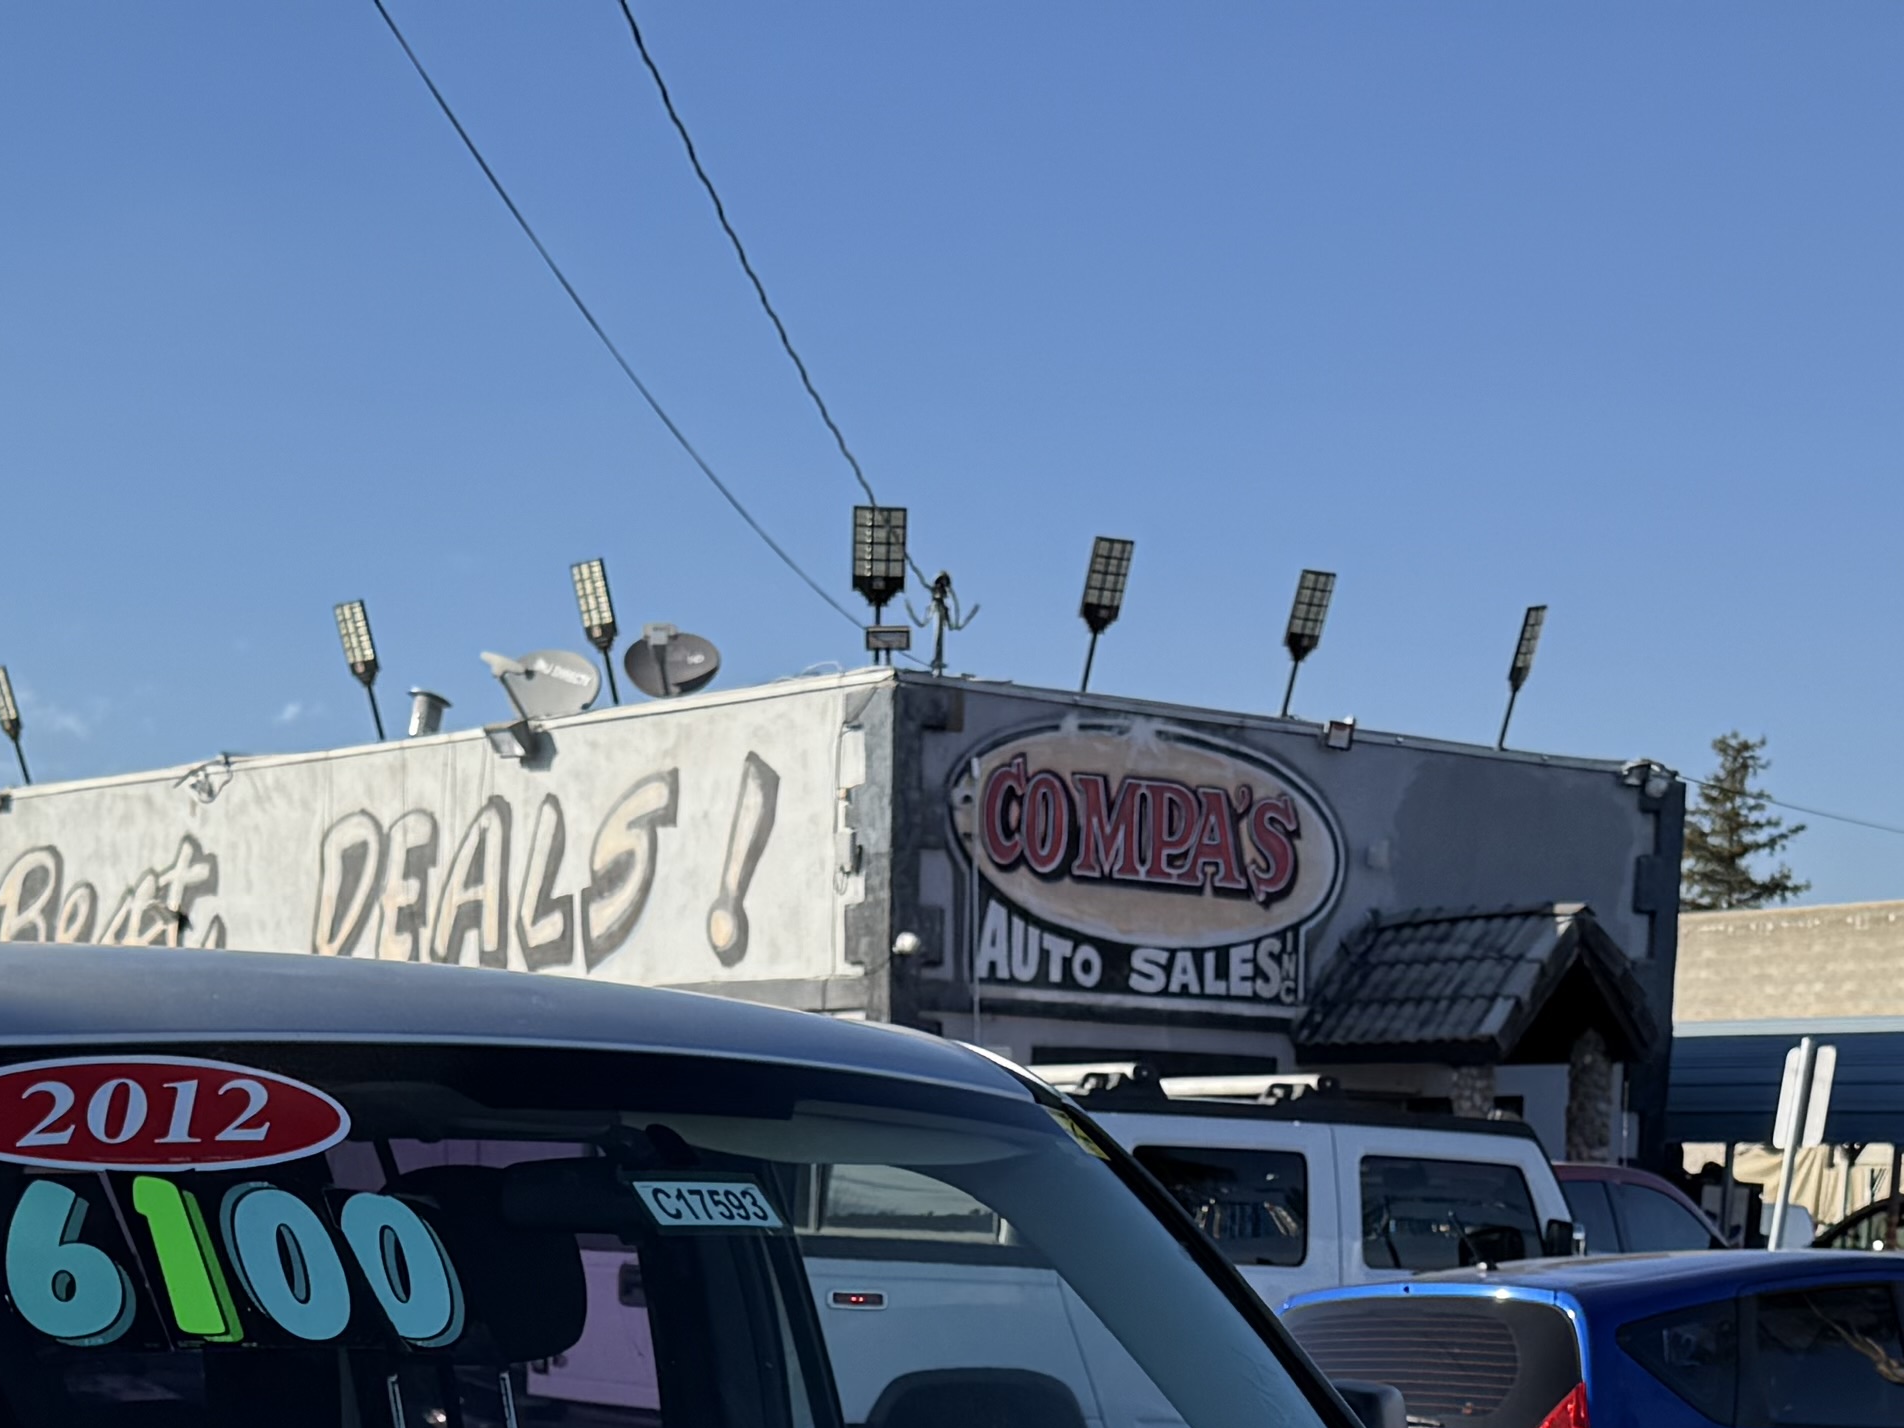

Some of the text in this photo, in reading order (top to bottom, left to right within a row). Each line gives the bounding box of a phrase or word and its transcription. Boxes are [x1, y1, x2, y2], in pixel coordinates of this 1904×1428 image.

[982, 751, 1302, 909] COMPA'S
[976, 899, 1282, 1000] AUTO SALES
[14, 1076, 272, 1149] 2012
[651, 1187, 769, 1222] C17593
[4, 1174, 465, 1348] 6100
